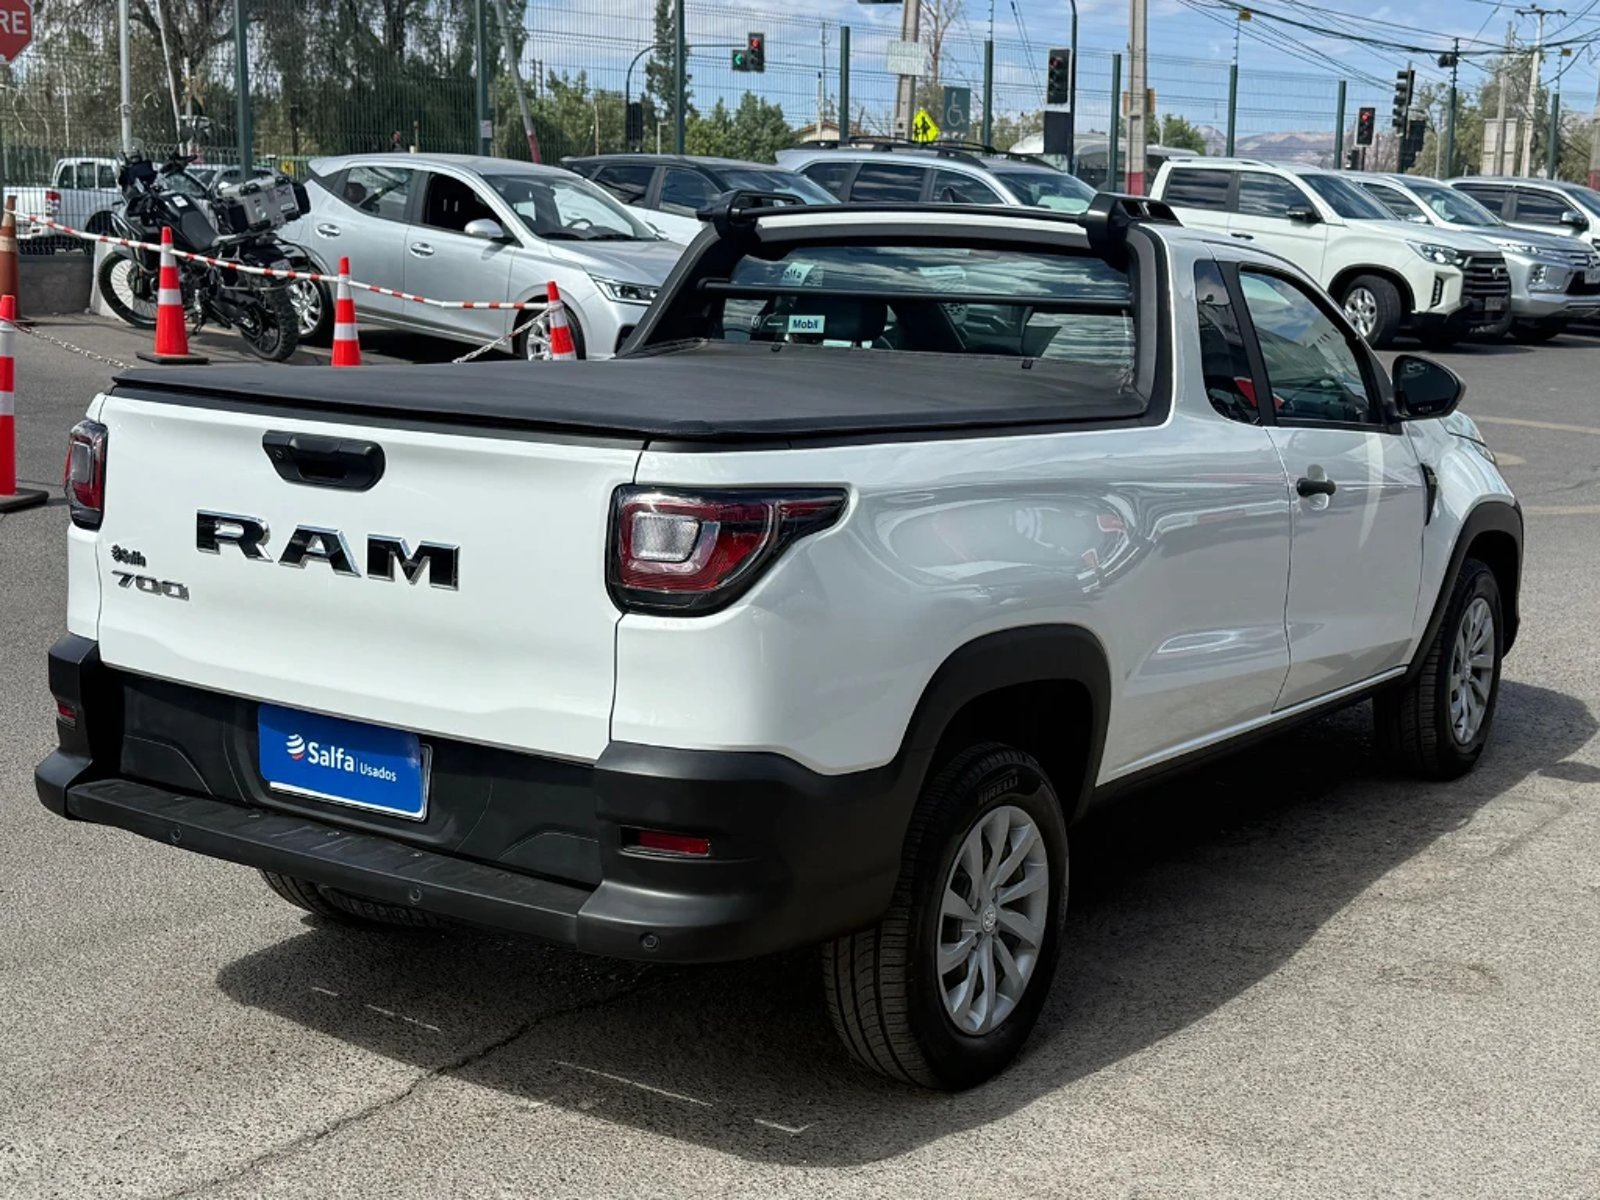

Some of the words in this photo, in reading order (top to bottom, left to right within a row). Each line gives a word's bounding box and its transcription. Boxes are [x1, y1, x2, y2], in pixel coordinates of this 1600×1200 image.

[196, 508, 460, 591] RAM
[111, 570, 189, 601] 700
[307, 741, 354, 772] Salfa
[359, 762, 397, 782] Usados
